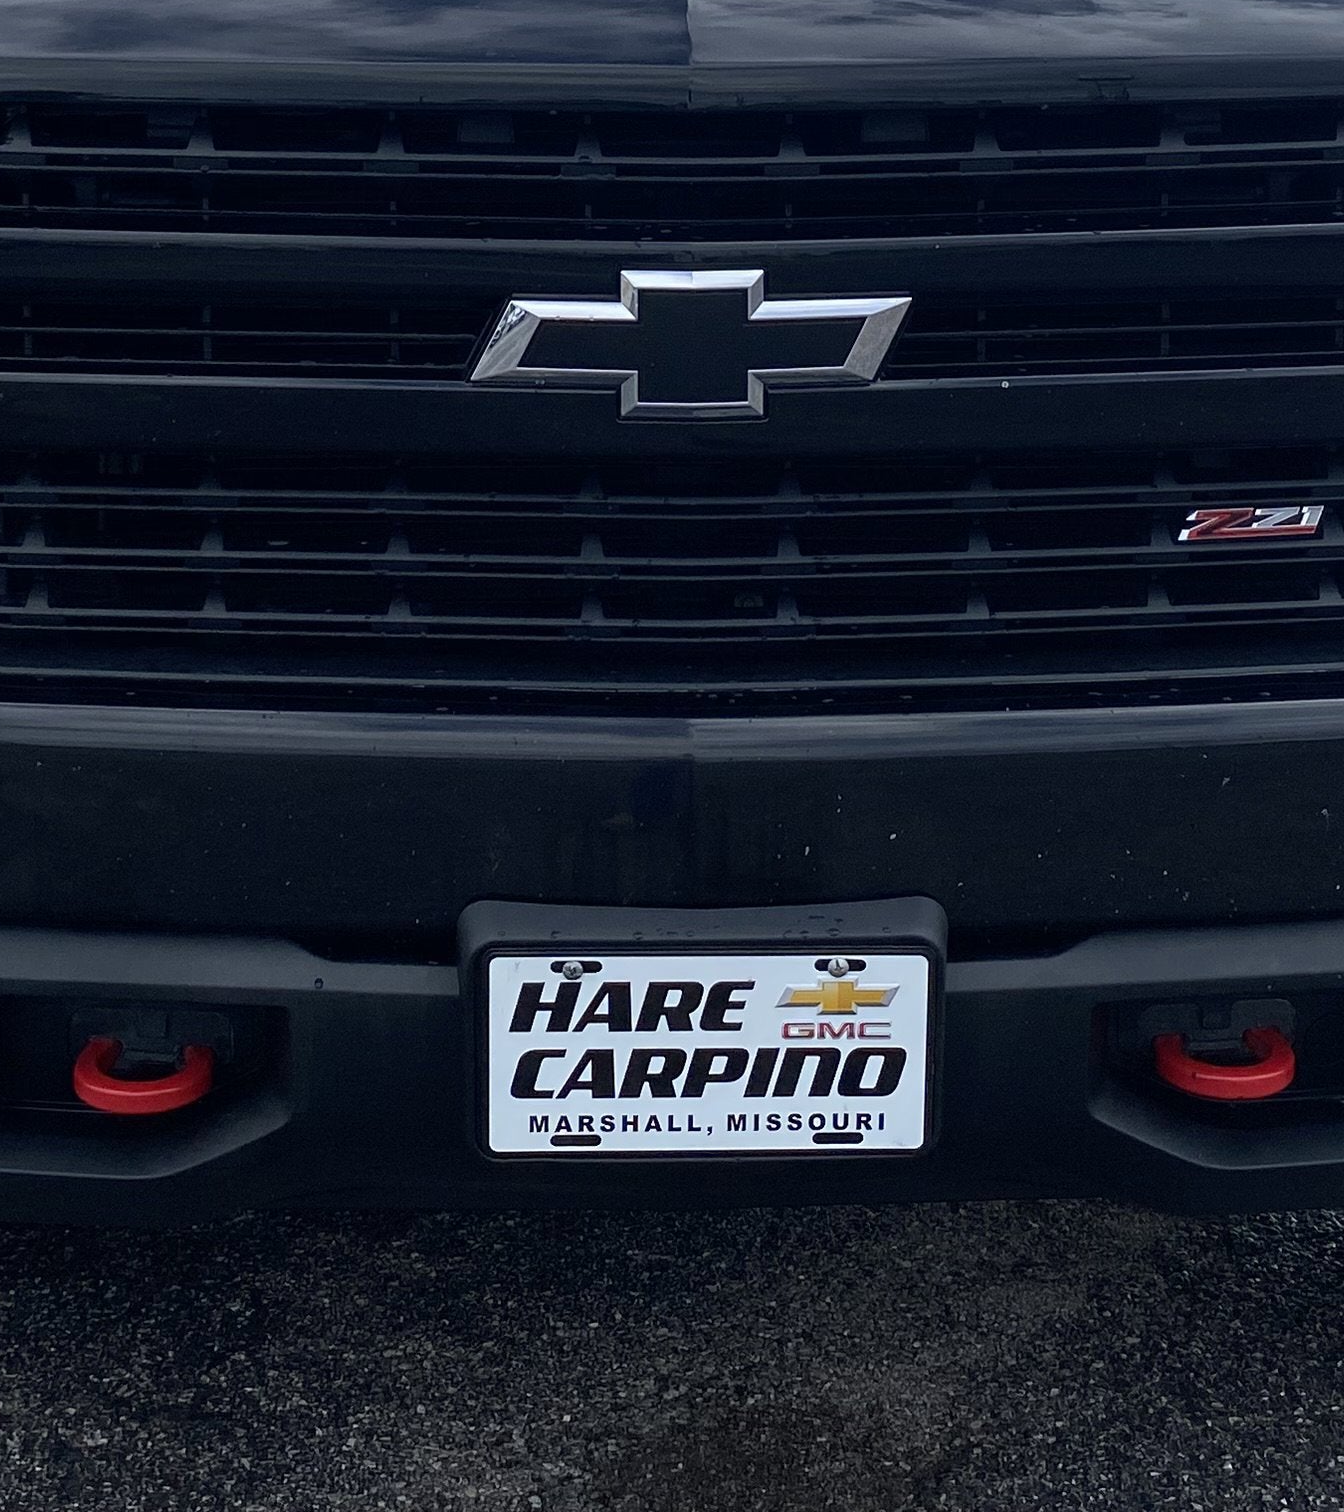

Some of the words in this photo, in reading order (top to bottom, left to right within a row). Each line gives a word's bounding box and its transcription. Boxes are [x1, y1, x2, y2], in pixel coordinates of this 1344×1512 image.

[1177, 505, 1325, 541] Z71
[508, 979, 756, 1033] HARE
[781, 1021, 893, 1040] GMC
[509, 1047, 908, 1100] CARPINO
[528, 1114, 714, 1136] MARSHALL,
[726, 1113, 886, 1132] MISSOURI
